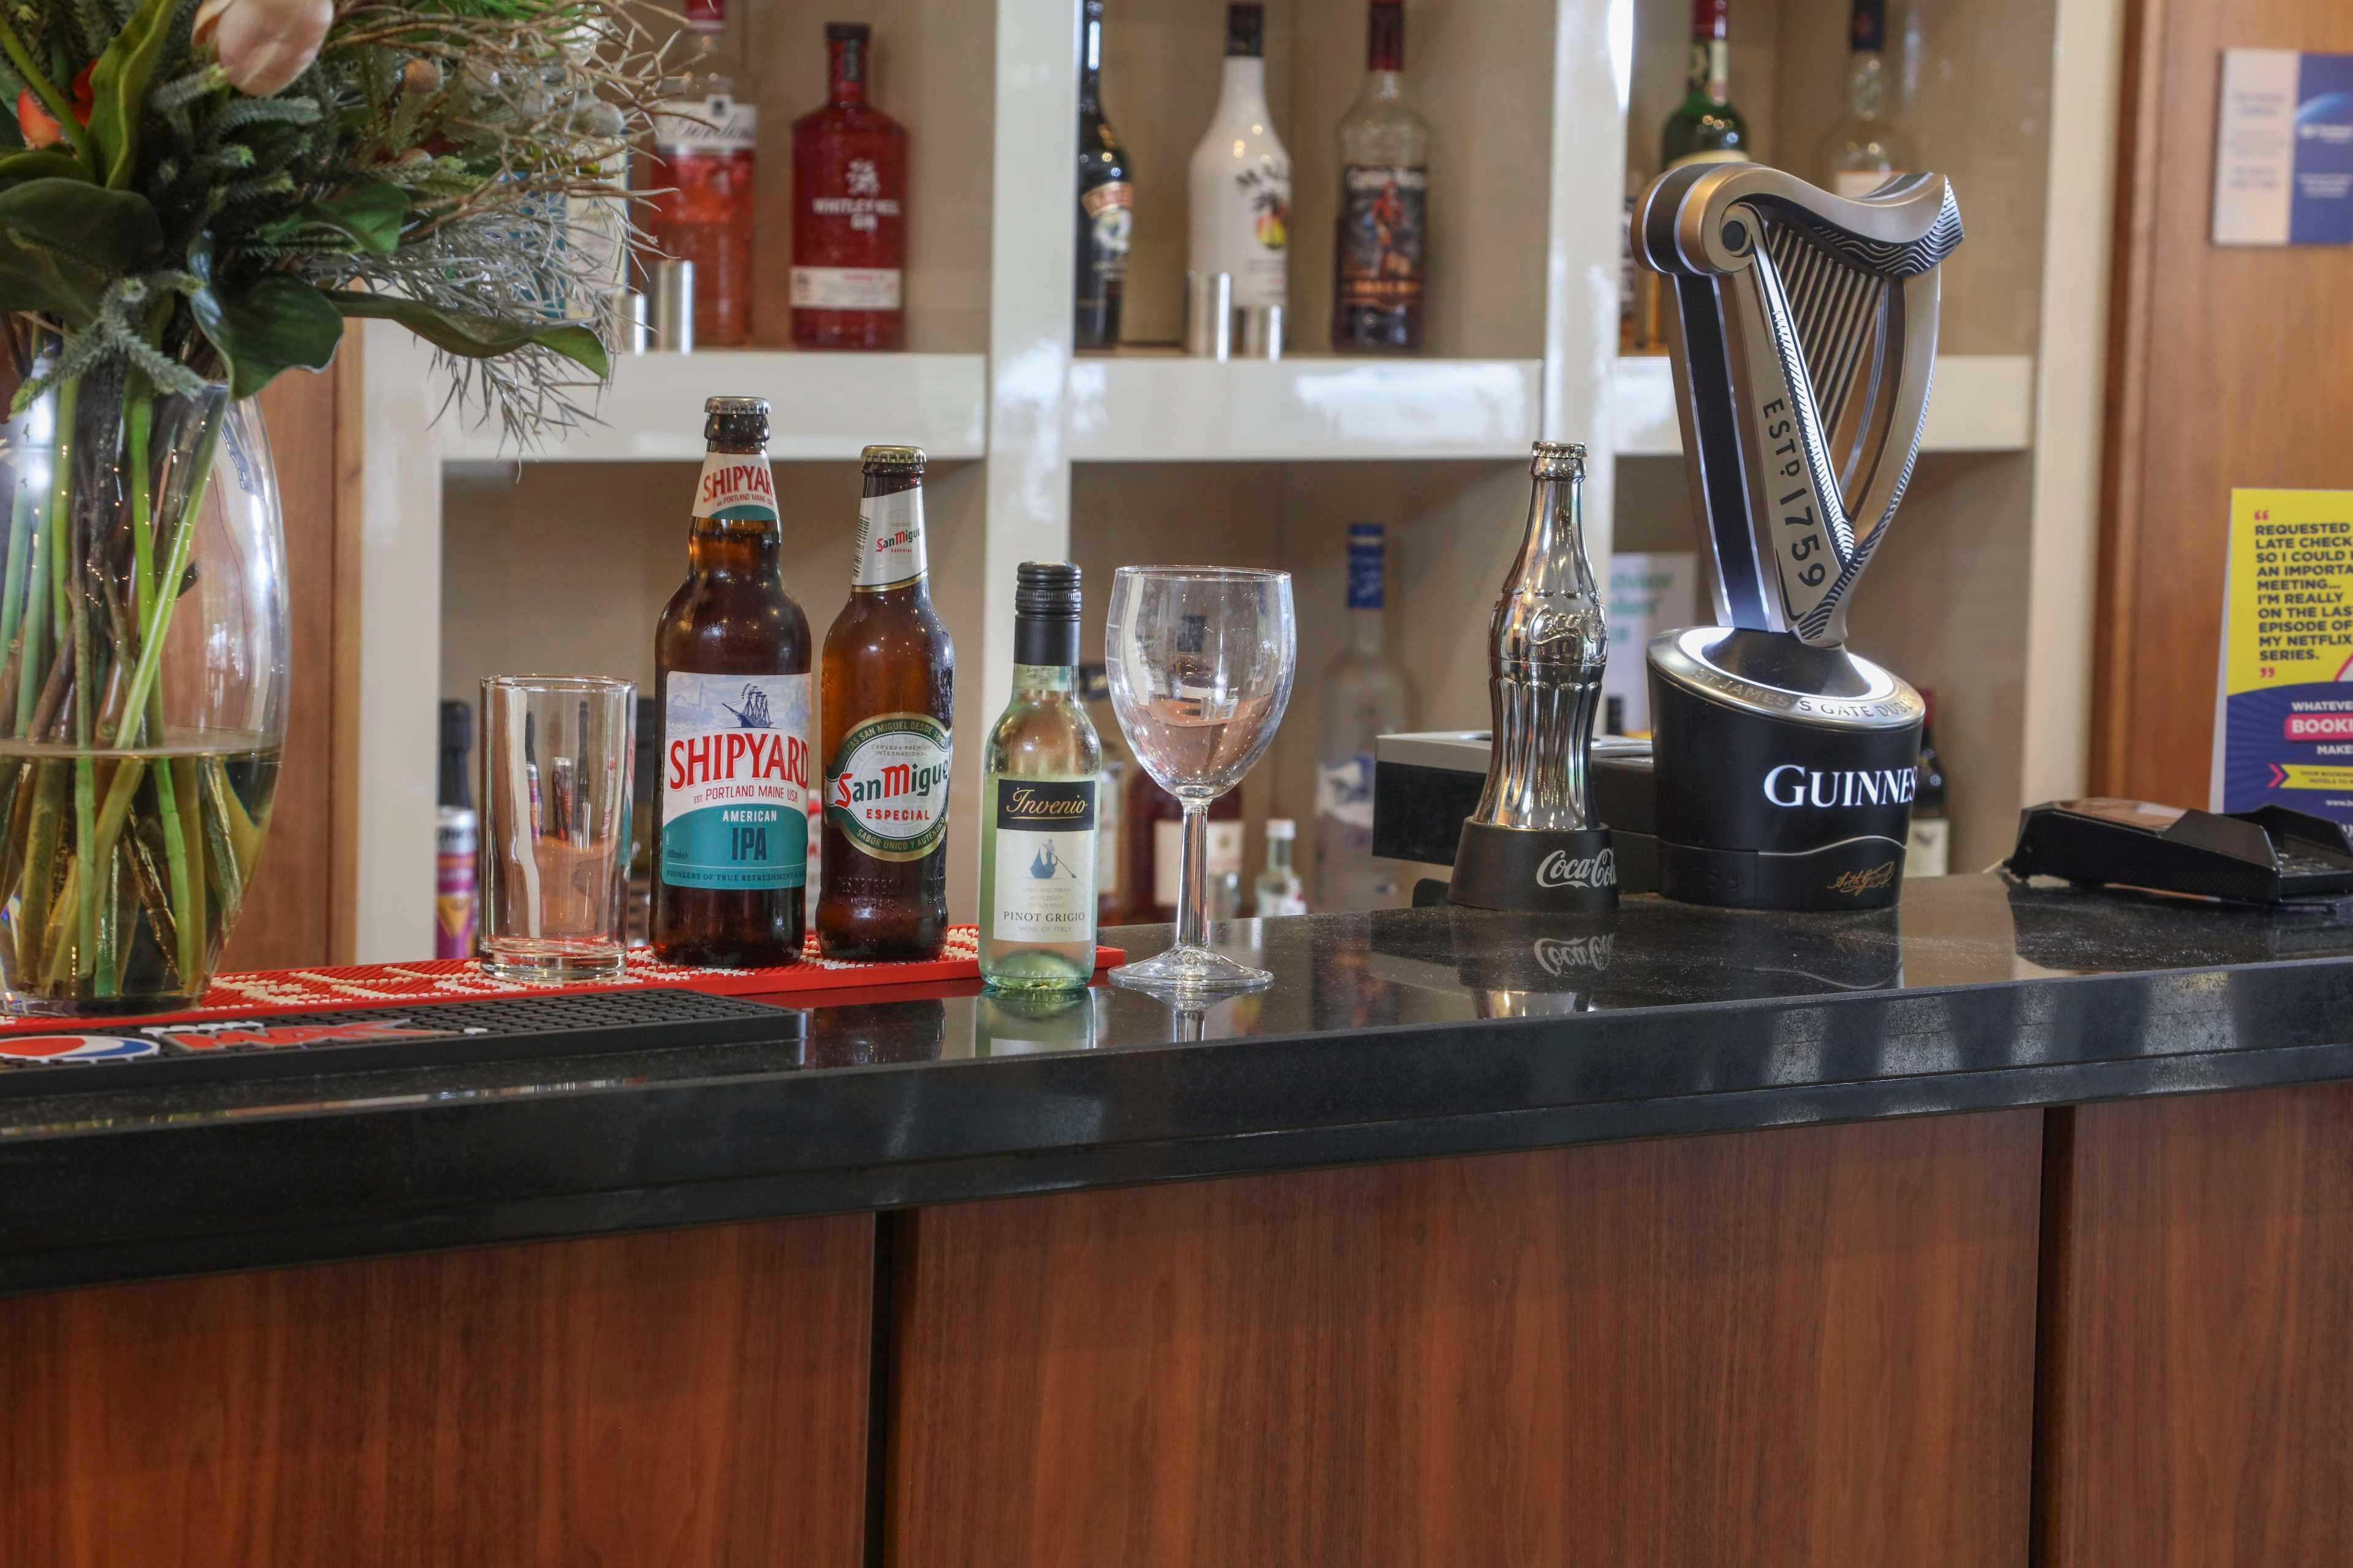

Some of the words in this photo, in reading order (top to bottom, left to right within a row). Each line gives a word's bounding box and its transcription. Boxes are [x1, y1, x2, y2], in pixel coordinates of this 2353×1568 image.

[724, 493, 750, 504] PORTLAND
[751, 493, 766, 502] MAINE
[2255, 523, 2351, 536] REQUESTED
[1780, 488, 1826, 587] 1759
[2256, 537, 2295, 550] LATE
[2256, 551, 2278, 563] SO
[2282, 551, 2286, 562] I
[2291, 550, 2346, 563] COULD
[2257, 566, 2279, 577] AN
[2284, 564, 2353, 576] IMPORTA
[2258, 594, 2279, 605] I'M
[2284, 592, 2344, 604] REALLY
[2258, 607, 2281, 619] ON
[2286, 607, 2317, 618] THE
[2259, 620, 2327, 633] EPISODE
[2332, 619, 2352, 631] OF
[2259, 635, 2282, 647] MY
[2287, 634, 2352, 646] NETFLIX
[2260, 648, 2320, 661] SERIES.
[1820, 704, 1874, 718] GATE
[2291, 701, 2353, 711] WHATEVE
[859, 727, 876, 740] SAN
[877, 721, 908, 733] MIGUEL
[910, 722, 932, 735] DESDE
[670, 733, 809, 790] SHIPYARD
[705, 785, 755, 801] PORTLAND
[758, 786, 785, 800] MAINE
[787, 788, 799, 803] USA
[1006, 788, 1089, 814] Invenio
[722, 810, 778, 822] AMERICAN
[866, 808, 930, 822] ESPECIAL
[731, 827, 767, 861] IPA
[857, 828, 881, 847] SABOR
[666, 869, 701, 881] PIONEERS
[1003, 911, 1041, 922] PINOT
[1045, 911, 1085, 922] GRIGIO
